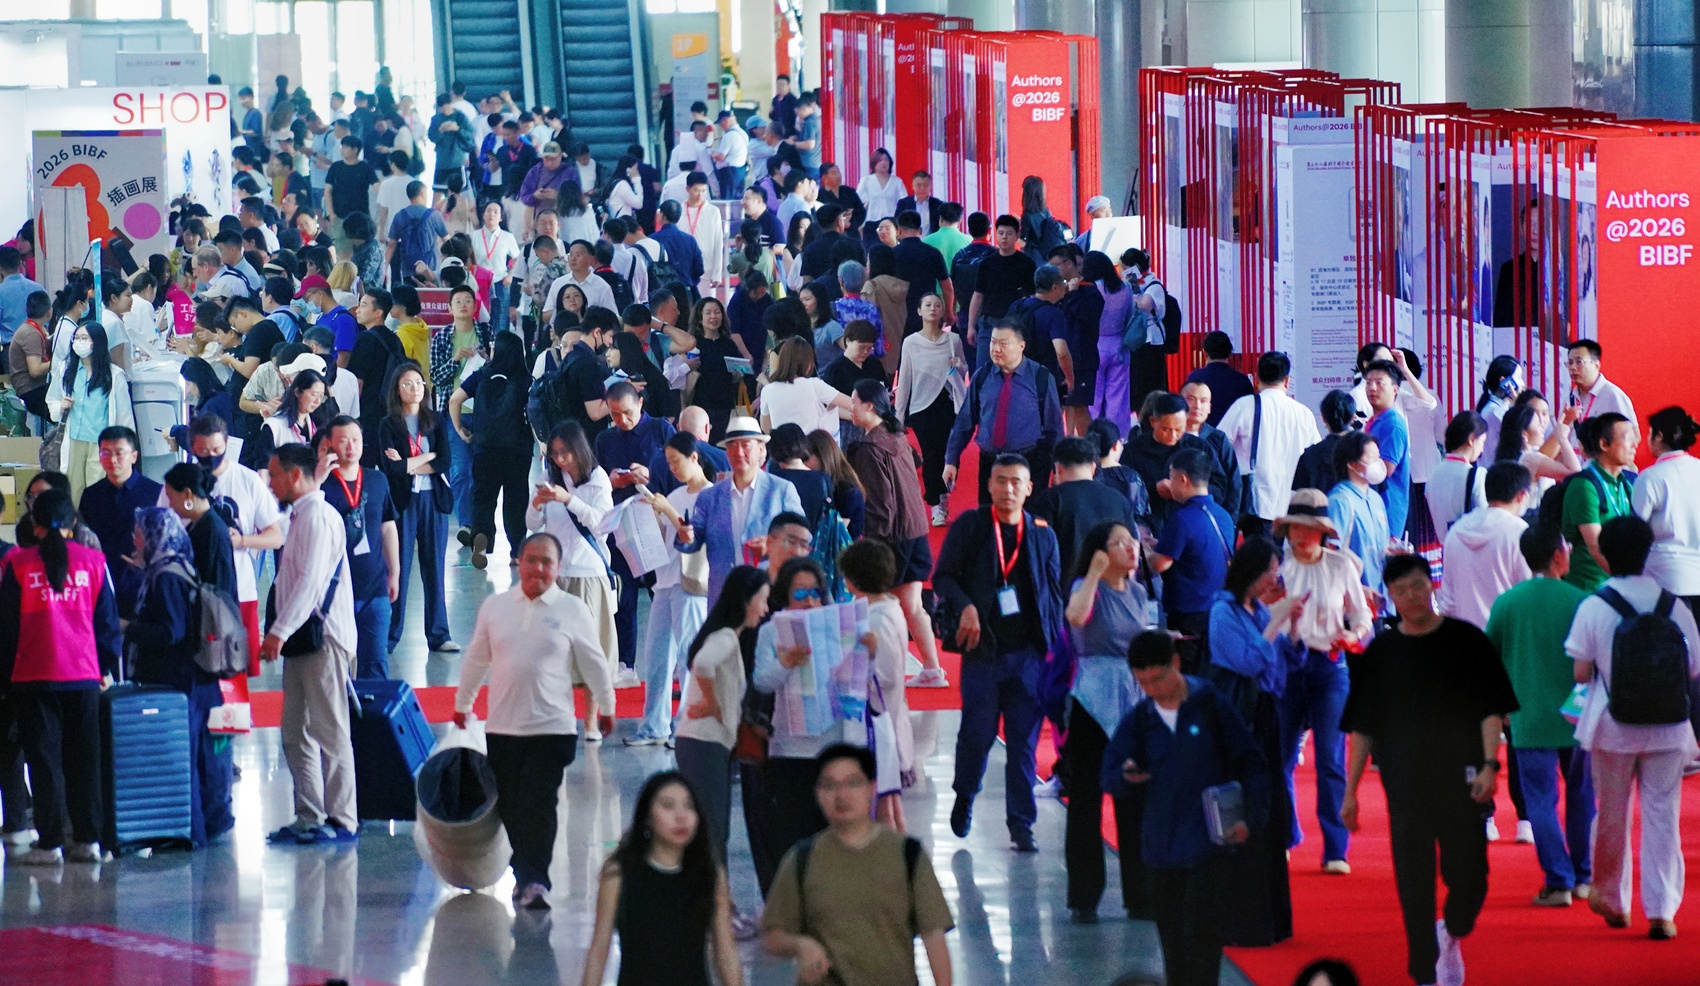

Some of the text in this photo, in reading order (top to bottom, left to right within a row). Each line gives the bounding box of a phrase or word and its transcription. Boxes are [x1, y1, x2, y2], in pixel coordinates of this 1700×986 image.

[1011, 75, 1063, 87] Authors
[112, 91, 227, 124] SHOP
[1012, 91, 1060, 107] @2026
[1032, 107, 1065, 122] BIBF
[36, 144, 108, 180] 2026 BIBF
[107, 176, 159, 207] 插画展
[1605, 189, 1690, 209] Authors
[1606, 217, 1686, 242] @2026
[1640, 244, 1693, 266] BIBF
